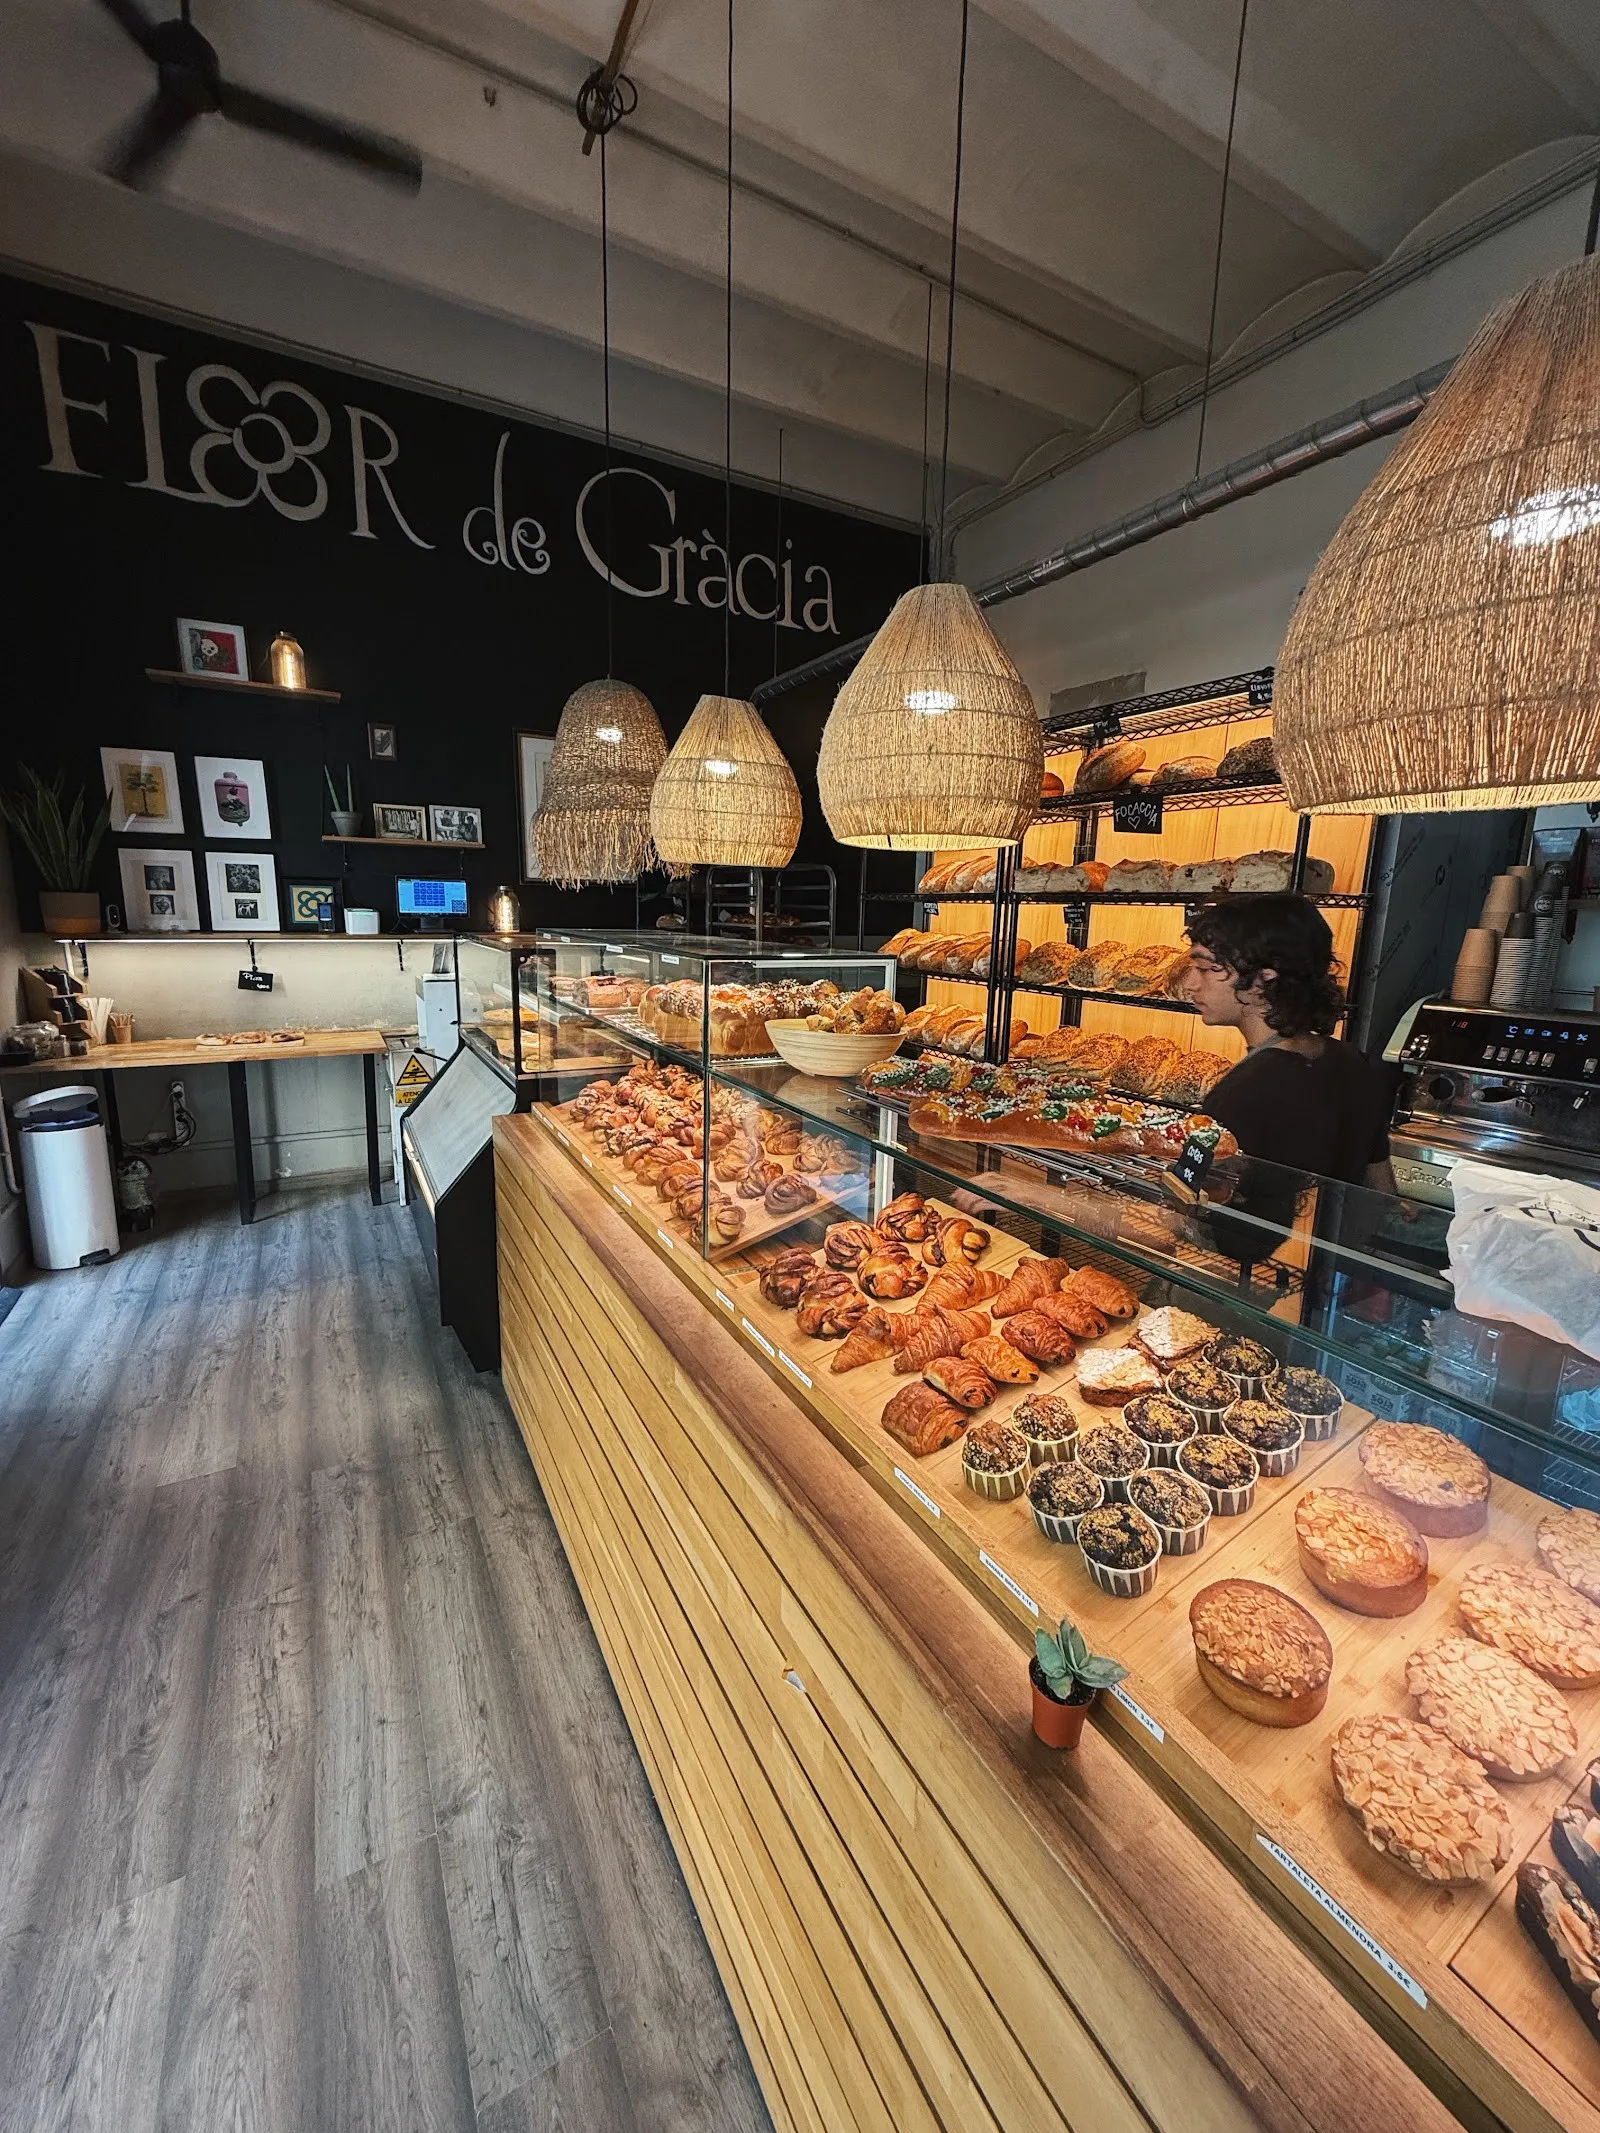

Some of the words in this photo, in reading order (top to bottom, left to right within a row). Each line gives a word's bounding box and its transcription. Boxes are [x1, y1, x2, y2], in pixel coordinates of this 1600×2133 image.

[24, 320, 435, 550] FLOR
[462, 430, 551, 575] de
[575, 466, 840, 636] Gràcia
[1270, 1842, 1323, 1899] TARTALETA
[1323, 1898, 1383, 1960] ALMENDRA
[1386, 1961, 1412, 1989] 3.5€
